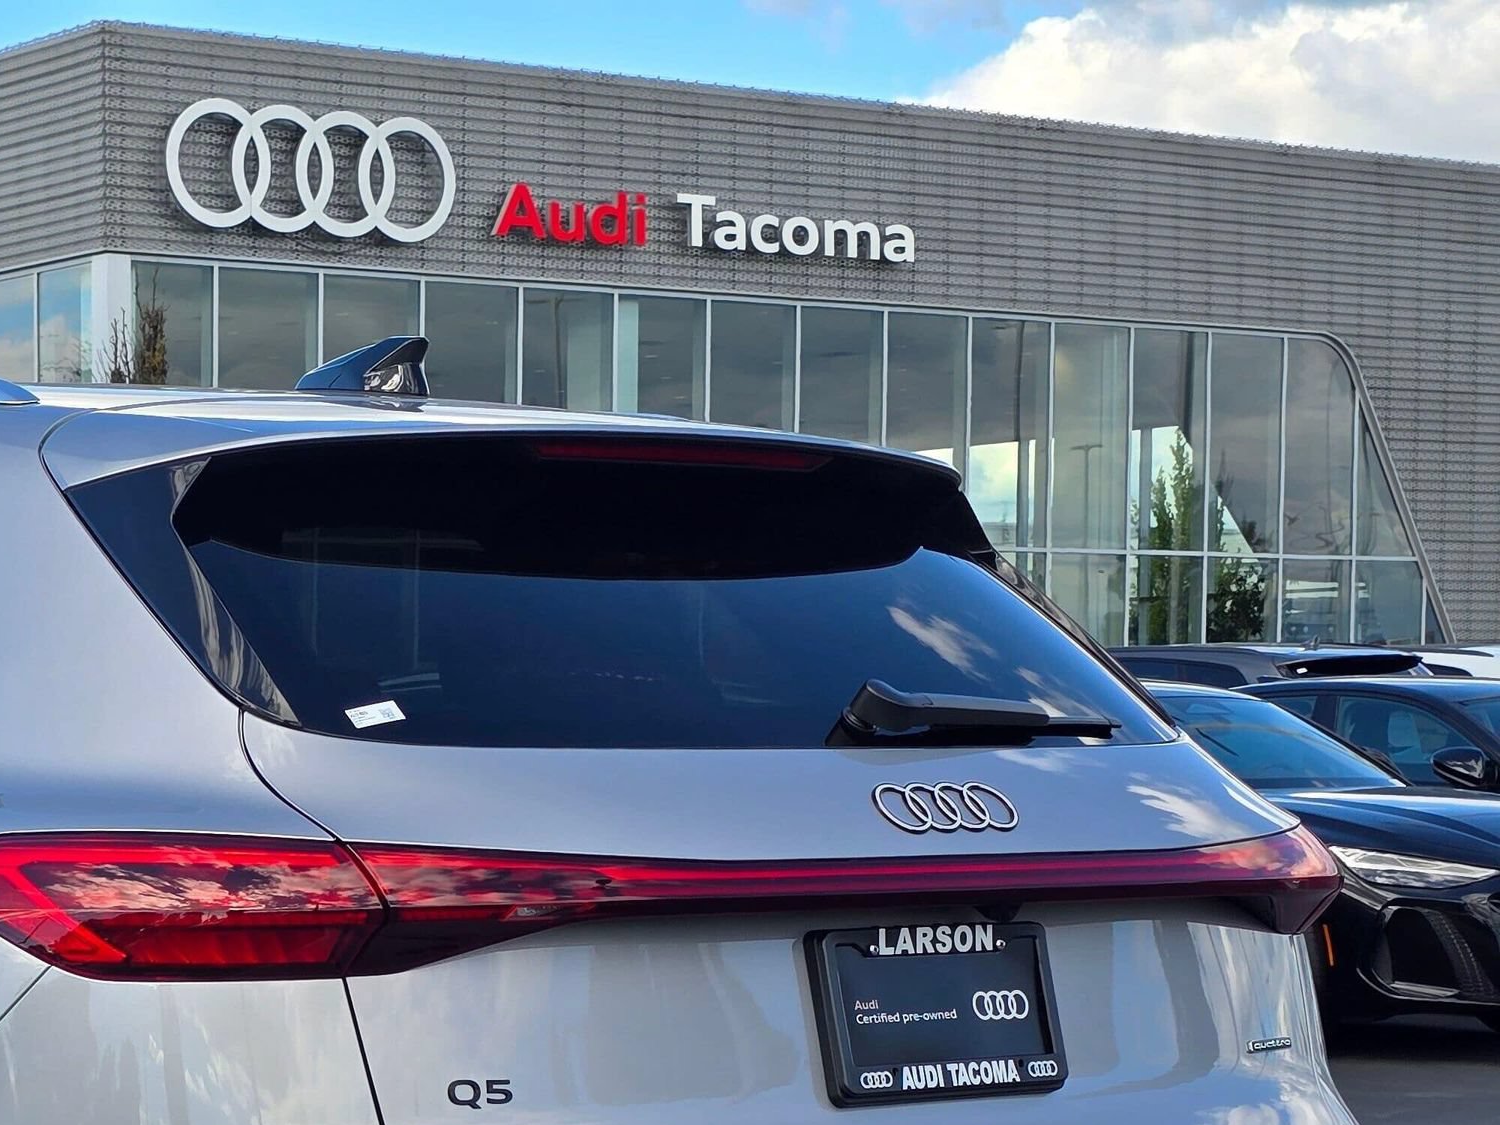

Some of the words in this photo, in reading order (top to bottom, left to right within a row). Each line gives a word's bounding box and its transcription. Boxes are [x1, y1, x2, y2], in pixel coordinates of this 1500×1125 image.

[491, 181, 647, 247] Audi
[676, 193, 916, 263] Tacoma
[878, 924, 993, 956] LARSON
[854, 999, 879, 1010] Audi
[856, 1012, 900, 1025] Certified
[902, 1008, 958, 1025] pre-owned
[902, 1063, 945, 1090] AUDI
[946, 1059, 1021, 1087] TACOMA
[447, 1079, 513, 1109] Q5
